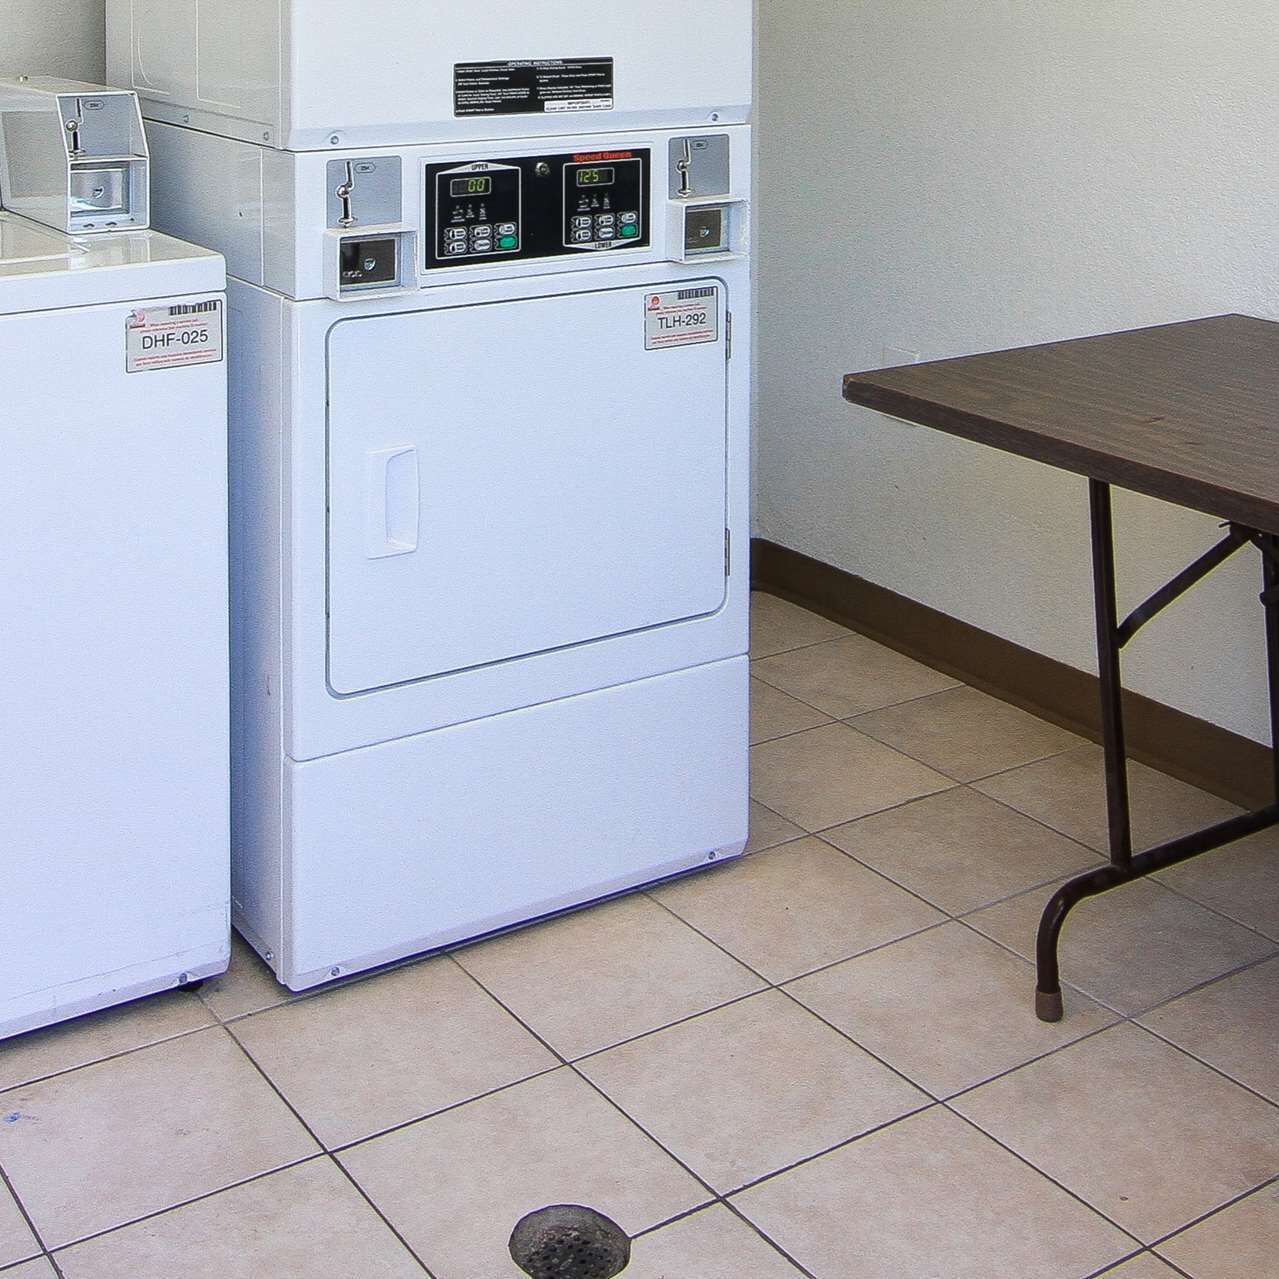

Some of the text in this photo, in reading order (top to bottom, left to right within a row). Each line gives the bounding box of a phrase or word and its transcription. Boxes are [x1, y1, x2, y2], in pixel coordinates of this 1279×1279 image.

[573, 150, 631, 163] Speed Queen
[471, 162, 488, 170] UPPER
[468, 178, 486, 192] 00
[594, 241, 612, 249] LOWER
[657, 312, 707, 329] TLH-292
[142, 329, 209, 350] DHF-025
